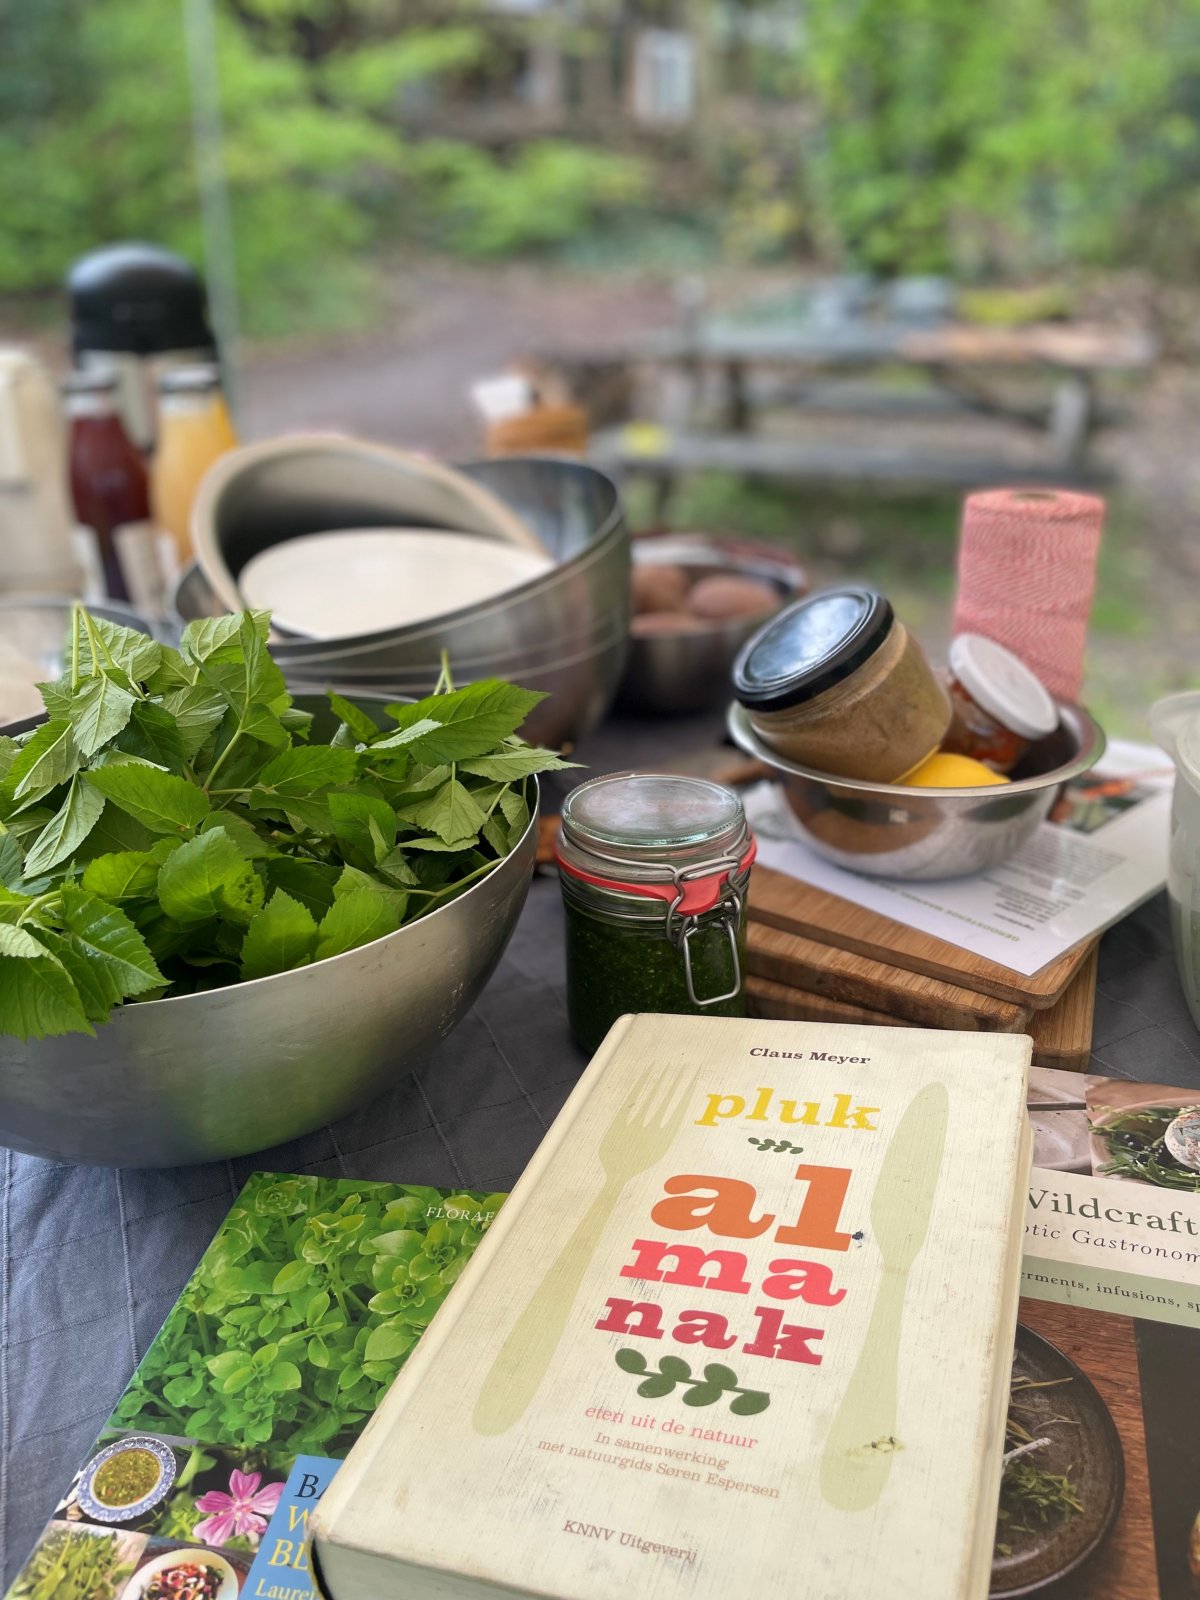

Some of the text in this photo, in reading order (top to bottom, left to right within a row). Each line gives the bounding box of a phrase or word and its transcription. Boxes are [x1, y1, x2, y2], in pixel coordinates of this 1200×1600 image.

[749, 1047, 871, 1065] Claus Meyer
[694, 1087, 881, 1131] pluk
[426, 1206, 495, 1222] FLORAF
[650, 1164, 853, 1252] al
[619, 1239, 848, 1307] ma
[1096, 1281, 1181, 1308] infusions,
[594, 1297, 825, 1366] nak
[585, 1406, 760, 1449] eten uit de natuur
[537, 1439, 780, 1499] met natuurgids Søren Espersen
[594, 1431, 729, 1471] In samenwerking
[294, 1473, 328, 1500] B
[562, 1519, 699, 1565] KNNV Uitgeverij
